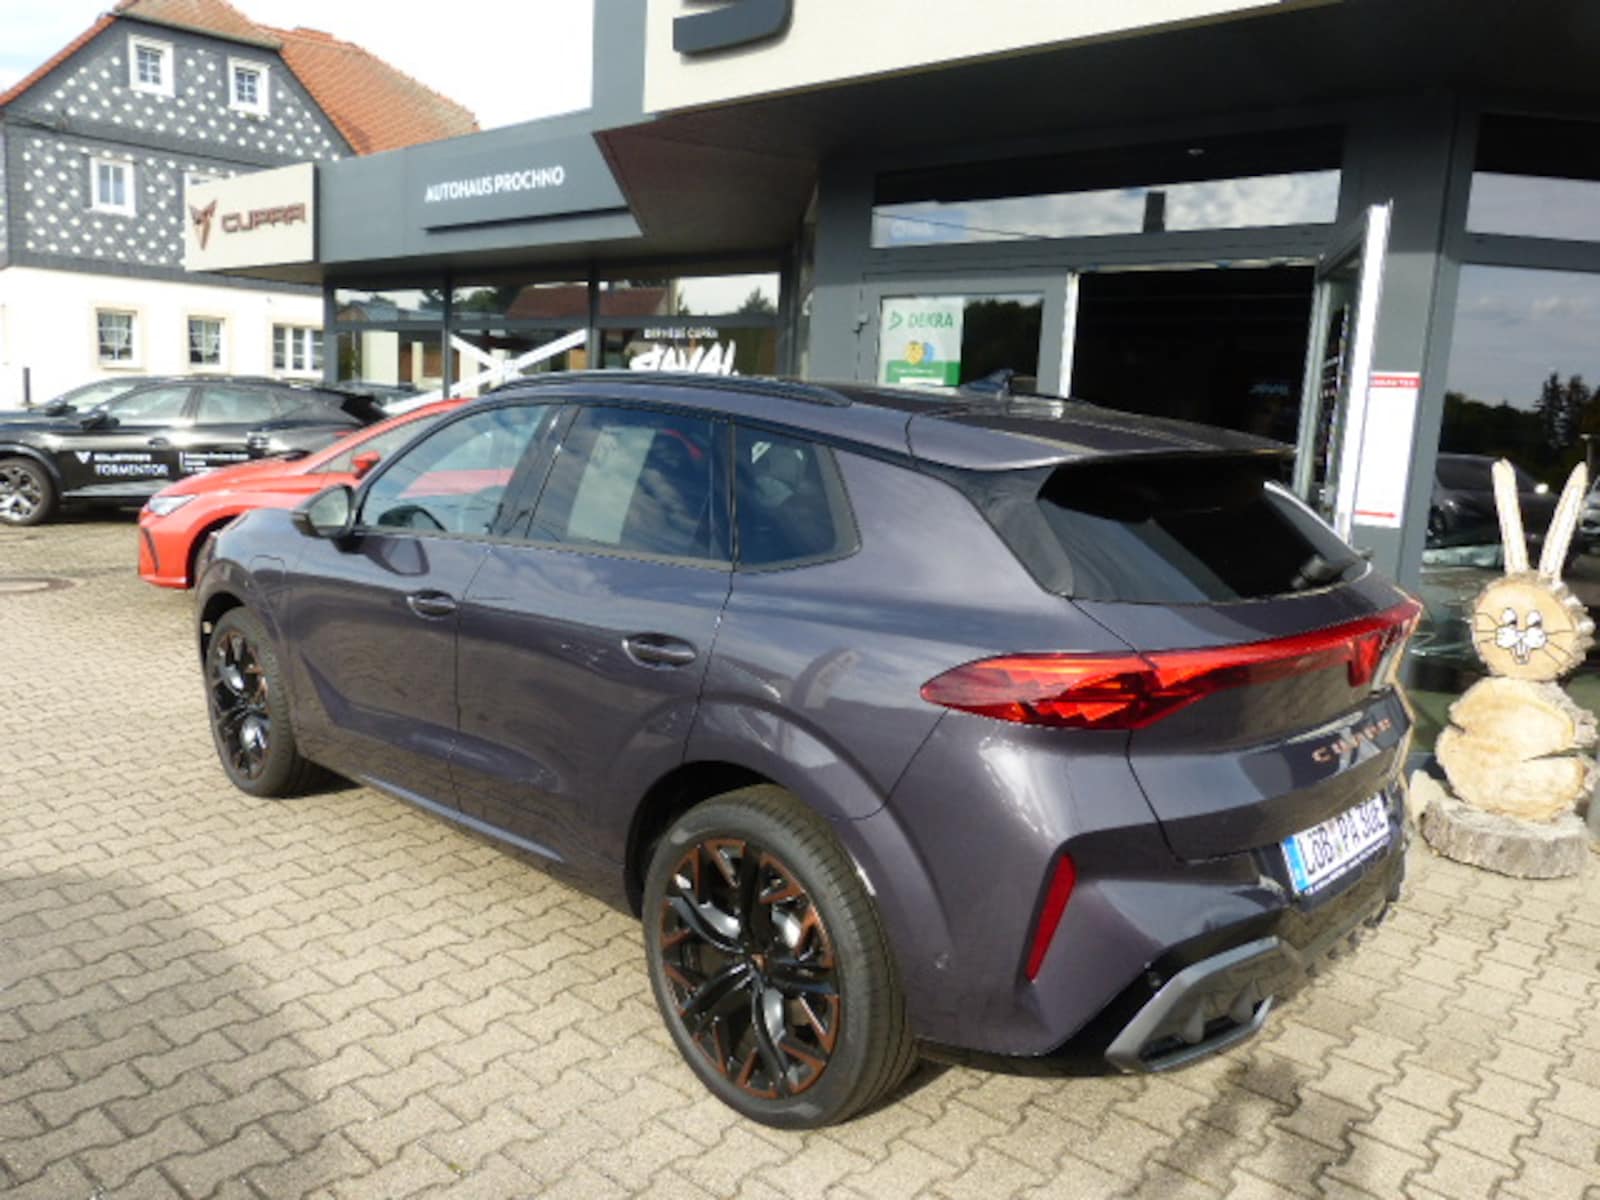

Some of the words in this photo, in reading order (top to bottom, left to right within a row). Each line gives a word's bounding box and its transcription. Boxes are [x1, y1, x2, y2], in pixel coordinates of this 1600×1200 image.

[424, 176, 493, 203] AUTOHAUS
[495, 165, 565, 192] PROCHNO
[222, 203, 305, 233] CUPRA
[907, 311, 954, 328] DEKRA
